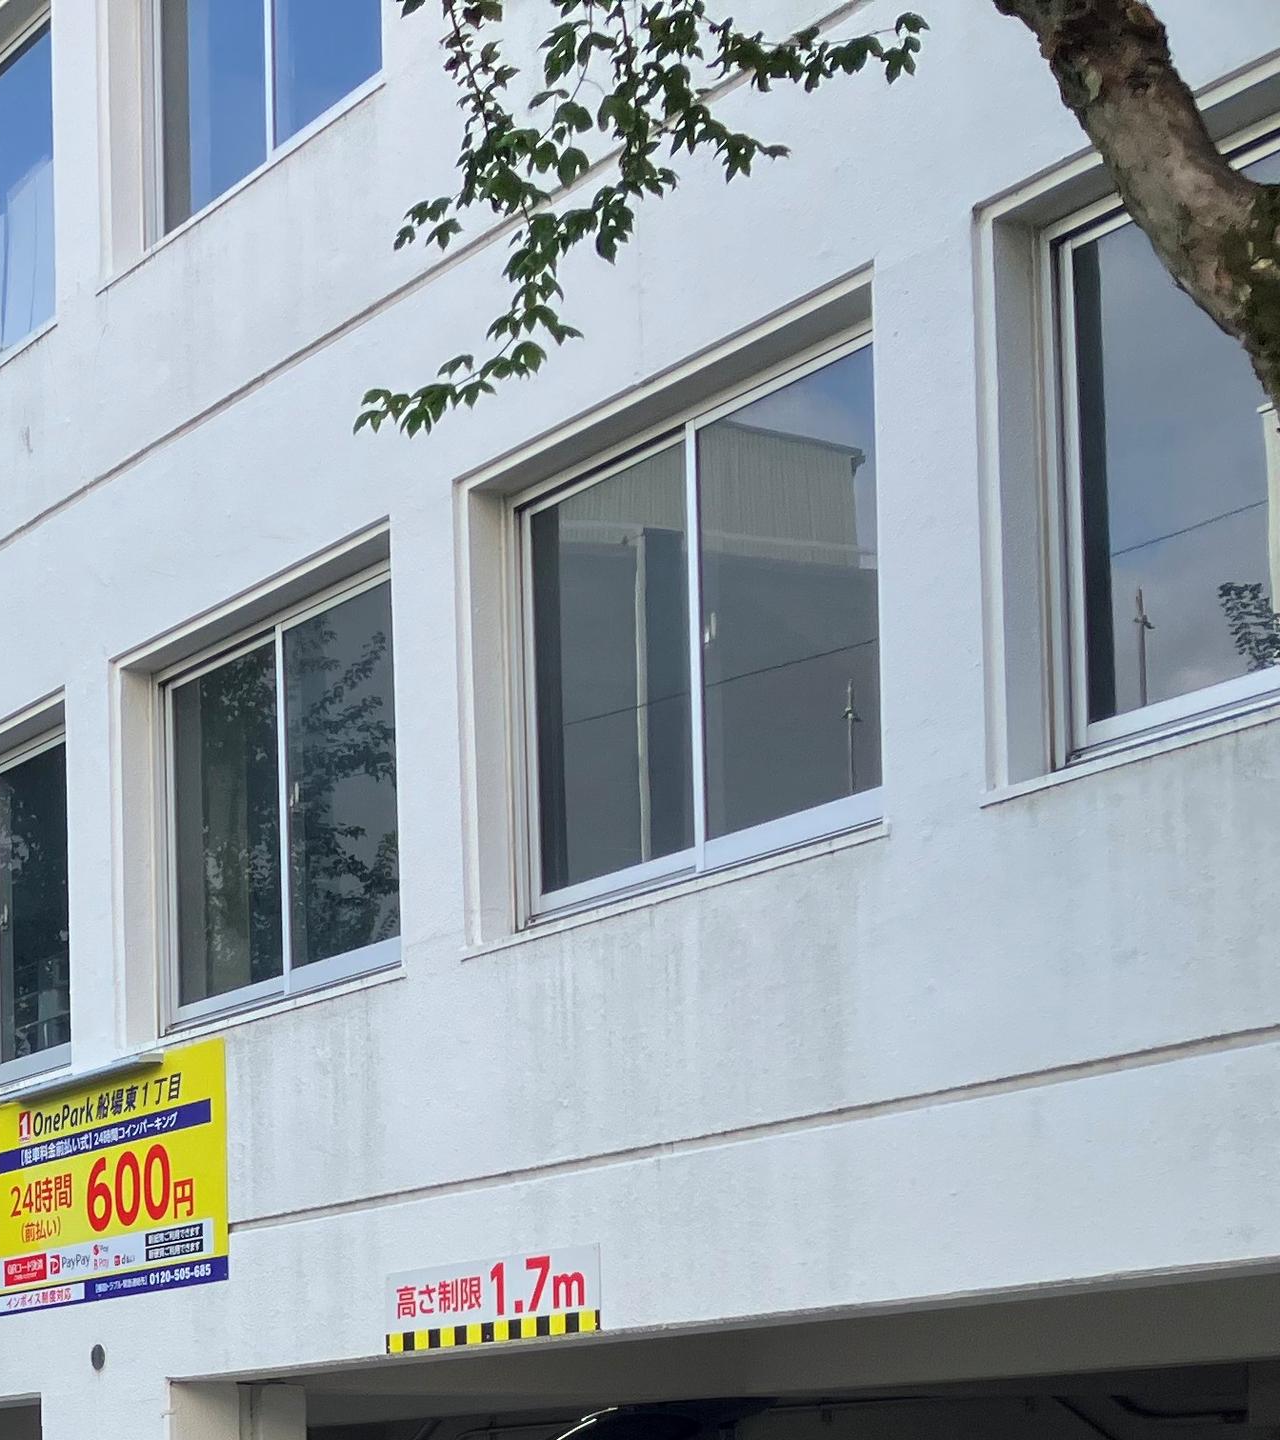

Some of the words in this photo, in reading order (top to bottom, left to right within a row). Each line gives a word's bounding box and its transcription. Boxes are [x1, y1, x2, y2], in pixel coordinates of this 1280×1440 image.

[33, 1097, 93, 1137] OnePark
[10, 1173, 72, 1217] 24時間
[86, 1144, 194, 1232] 600円
[62, 1254, 90, 1271] PayPay
[149, 1263, 211, 1285] 0120-505-685
[396, 1276, 481, 1319] 高さ制限
[490, 1255, 585, 1316] 1.7m
